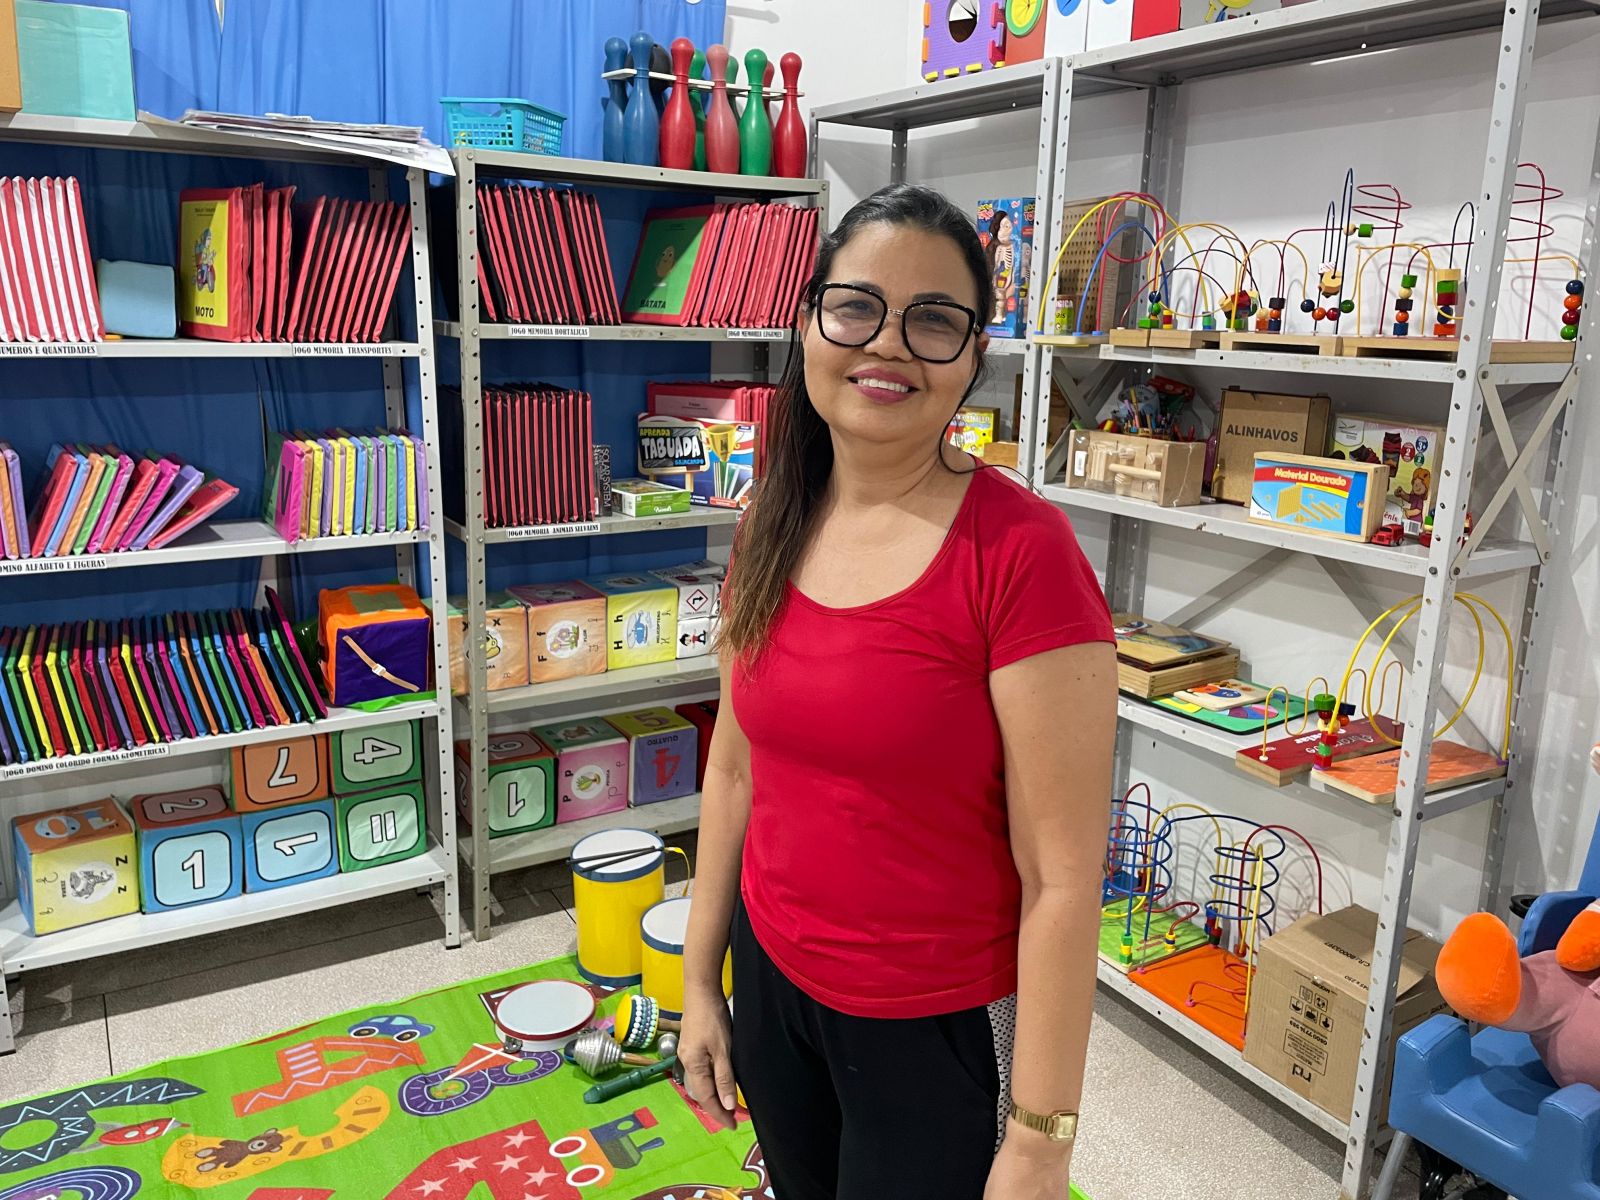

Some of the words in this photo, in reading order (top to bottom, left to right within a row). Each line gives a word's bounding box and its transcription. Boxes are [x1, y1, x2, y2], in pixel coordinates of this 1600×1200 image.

[195, 306, 214, 318] MOTO
[511, 327, 526, 335] JOGO
[528, 328, 553, 336] MEMORIA
[0, 345, 33, 355] UMEROS
[35, 346, 41, 355] E
[42, 345, 96, 355] QUANTIDADES
[294, 346, 312, 355] JOGO
[313, 346, 344, 355] MEMORIA
[348, 346, 392, 355] TRANSPORTES
[640, 428, 671, 437] APRENDA
[1226, 424, 1299, 443] ALINHAVOS
[641, 435, 701, 459] TABUADA
[1406, 448, 1412, 457] 2
[603, 448, 611, 476] SOLAR
[1274, 468, 1309, 481] Material
[1309, 473, 1347, 487] Dourado
[603, 477, 611, 507] SYSTEM
[524, 528, 549, 536] MEMORIA
[553, 525, 574, 534] ANIMAIS
[25, 562, 64, 571] ALFABETO
[66, 561, 72, 569] E
[73, 560, 106, 568] FIGURAS
[613, 614, 623, 623] h
[613, 640, 623, 650] H
[647, 735, 679, 746] QUATRO
[353, 737, 402, 764] 4
[6, 769, 24, 778] JOGO
[26, 763, 53, 774] DOMINO
[55, 757, 91, 769] COLORIDO
[92, 754, 119, 764] FORMAS
[121, 747, 166, 759] GEOMETRICAS
[267, 746, 298, 788] 7
[652, 748, 682, 788] 4
[161, 797, 208, 815] 2
[508, 781, 526, 817] 1
[273, 831, 318, 857] 1
[181, 849, 206, 890] 1
